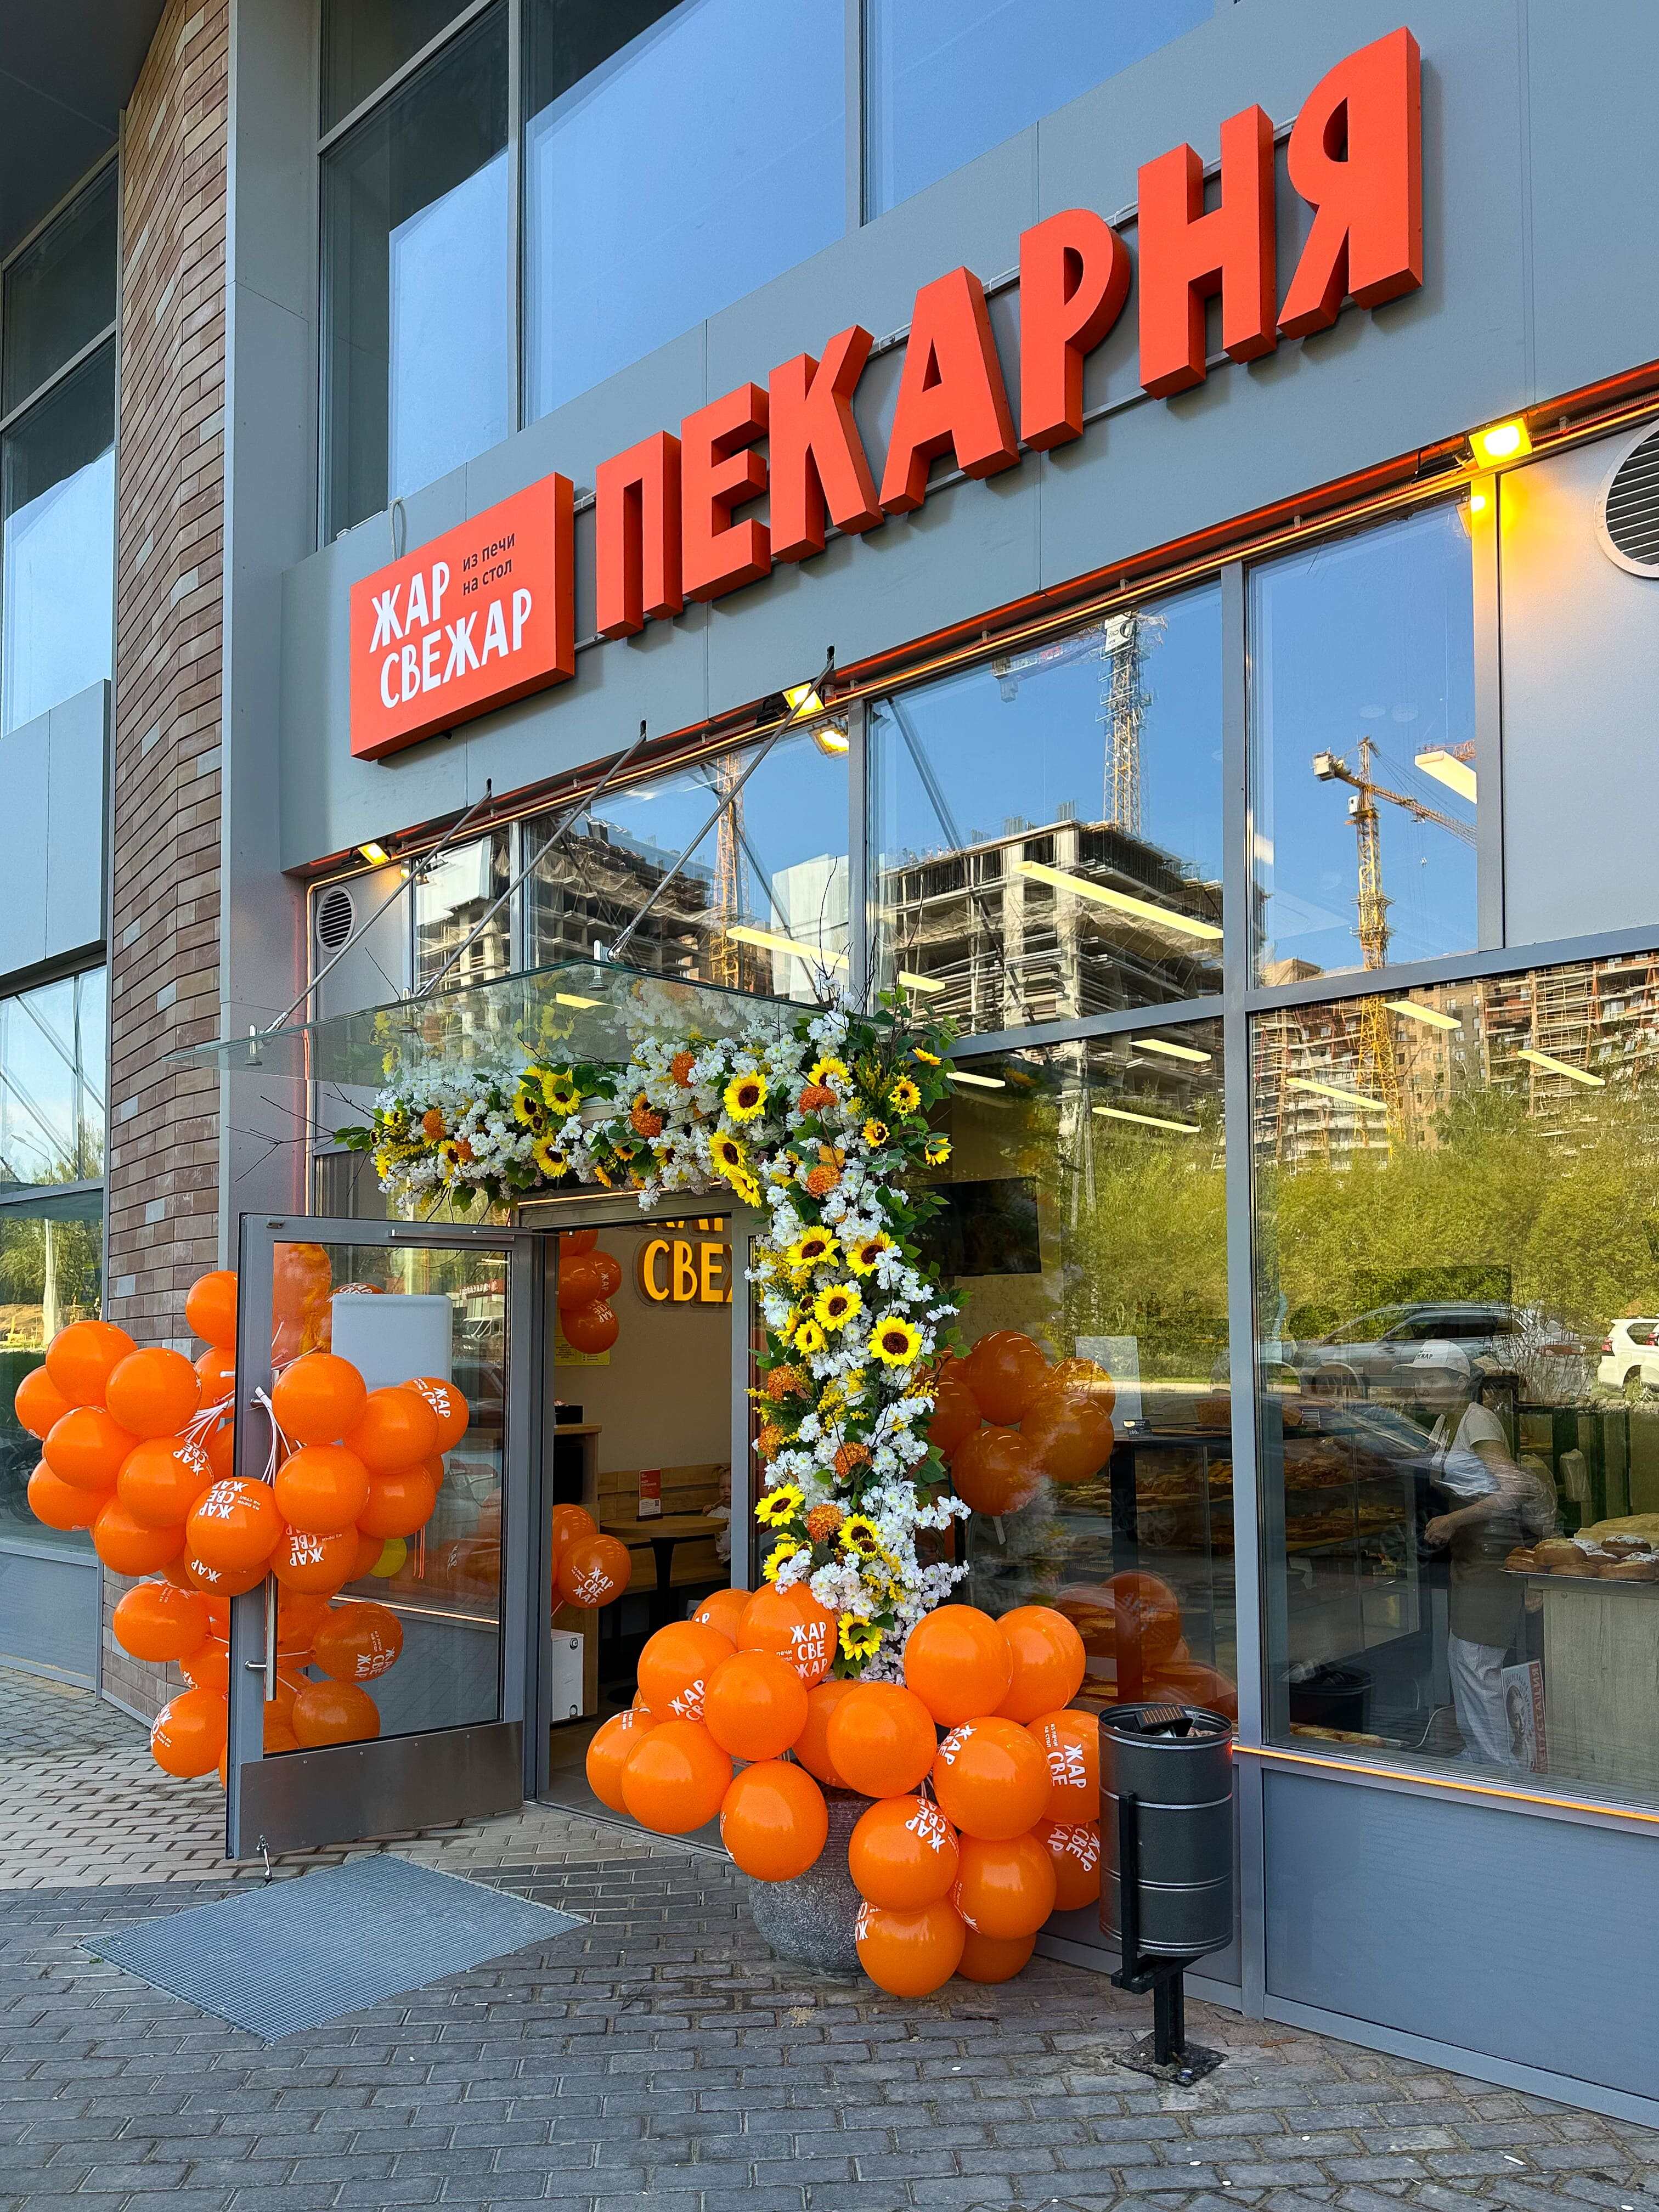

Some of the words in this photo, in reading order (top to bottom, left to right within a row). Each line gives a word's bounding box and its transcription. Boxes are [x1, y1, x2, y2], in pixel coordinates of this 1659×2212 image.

[595, 26, 1423, 640] ПЕКАРНЯ
[463, 556, 478, 572] из
[482, 533, 515, 562] печи
[463, 577, 478, 596] на
[482, 558, 512, 585] стол
[369, 561, 450, 653] ЖАР
[380, 588, 532, 709] СВЕЖАР
[641, 1238, 732, 1302] СВЕ
[432, 1387, 451, 1418] ЖАР
[173, 1449, 205, 1477] ЖАР
[207, 1490, 235, 1504] СВЕ
[212, 1481, 250, 1493] ЖАР
[199, 1502, 235, 1520] ЖАР
[289, 1547, 325, 1566] ЖАР
[290, 1534, 317, 1551] СВЕ
[191, 1559, 223, 1584] ЖАР
[588, 1566, 614, 1589] ЖАР
[572, 1585, 597, 1605] ЖАР
[584, 1579, 605, 1598] СВЕ
[790, 1621, 827, 1644] ЖАР
[797, 1640, 825, 1661] СВЕ
[354, 1653, 372, 1678] ЖАР
[369, 1655, 385, 1675] СВЕ
[794, 1658, 828, 1680] ЖАР
[667, 1679, 706, 1716] ЖАР
[944, 1724, 978, 1765] ЖАР
[1047, 1752, 1068, 1787] СВЕ
[1063, 1743, 1087, 1788] ЖАР
[916, 1805, 946, 1833] СВЕ
[905, 1816, 946, 1854] ЖАР
[1065, 1828, 1090, 1858] СВЕ
[1080, 1832, 1100, 1871] ЖАР
